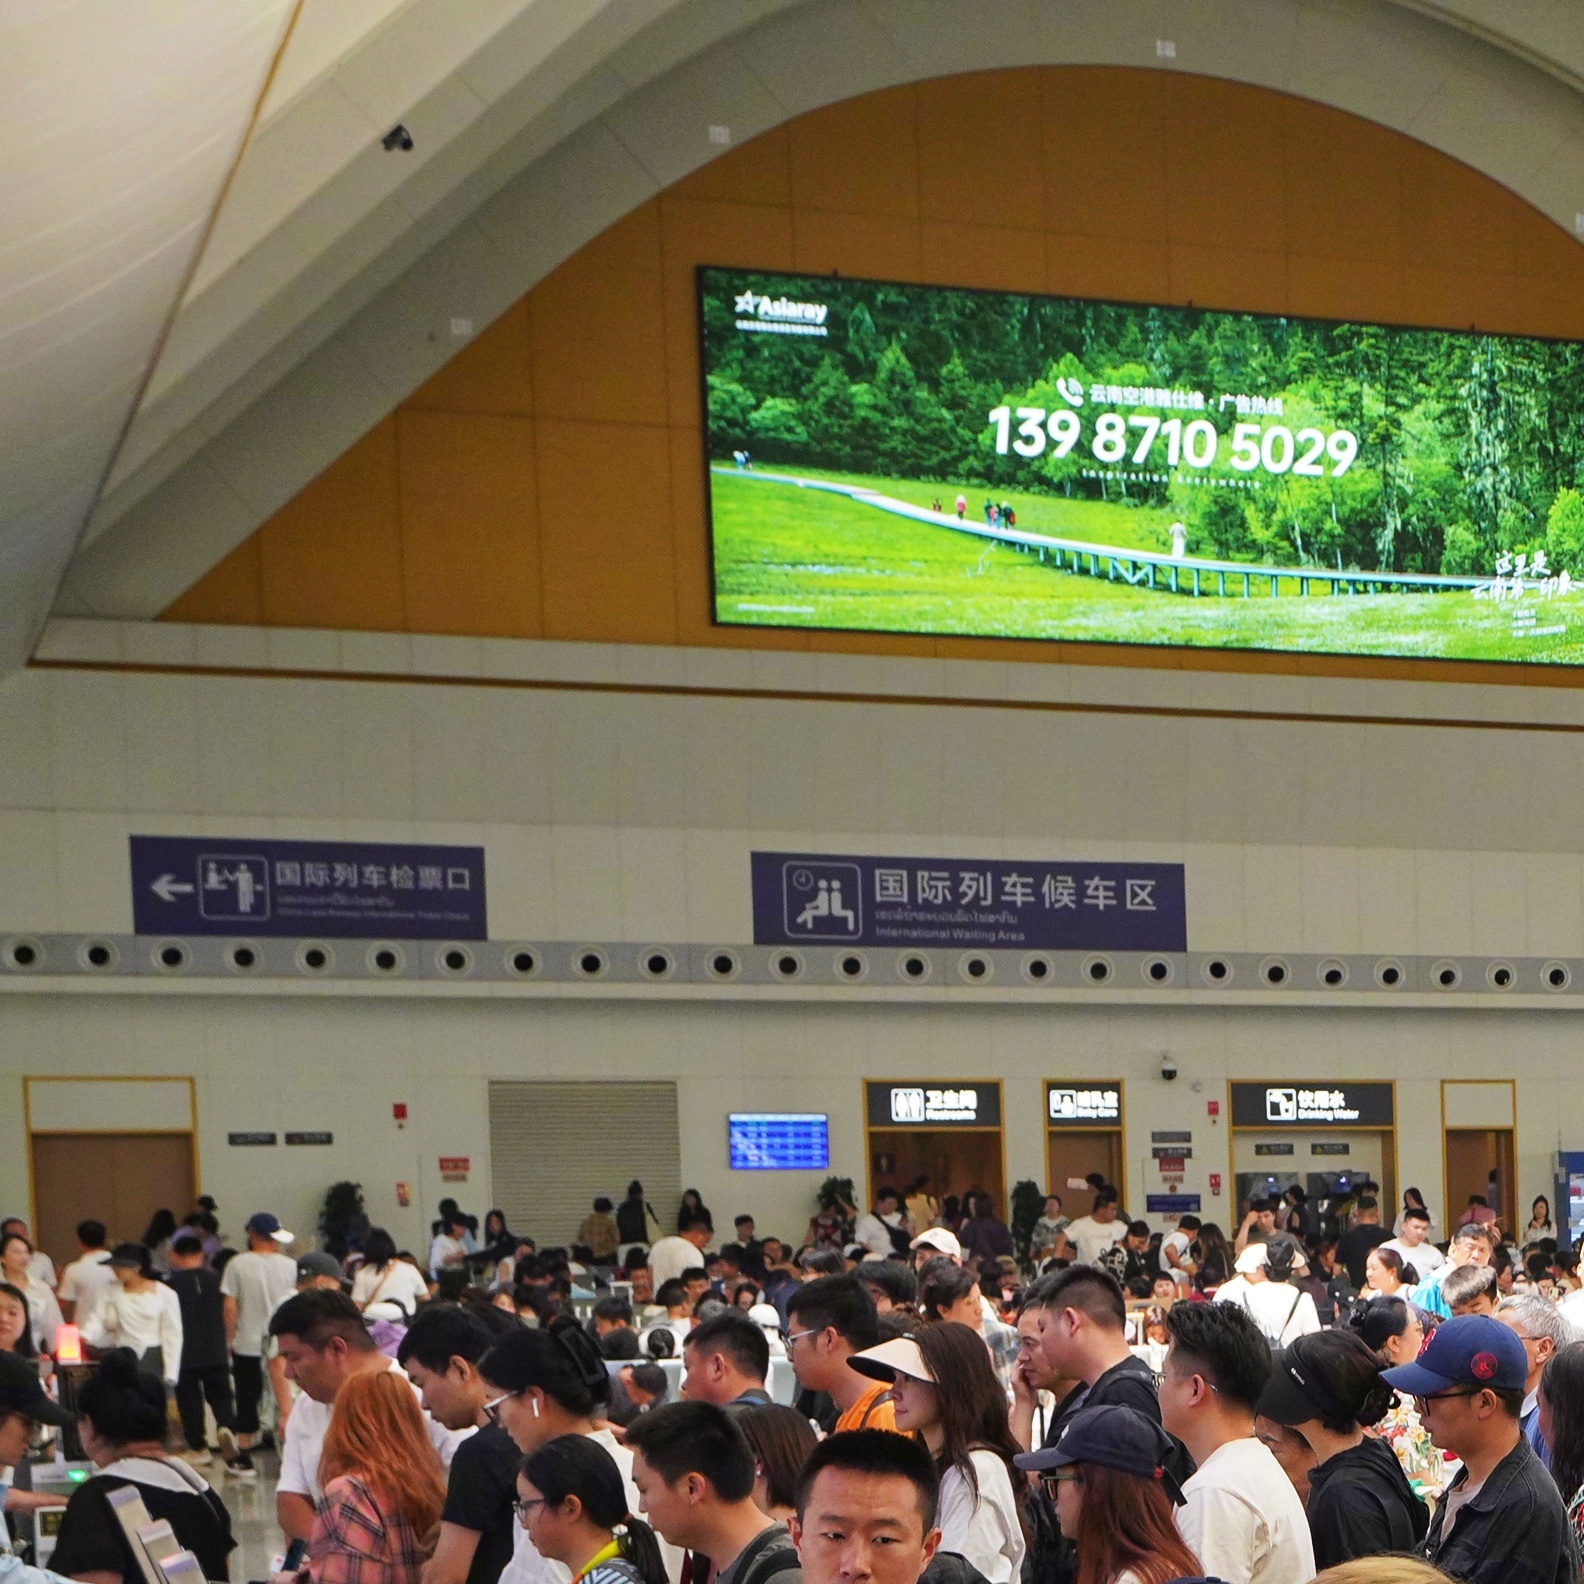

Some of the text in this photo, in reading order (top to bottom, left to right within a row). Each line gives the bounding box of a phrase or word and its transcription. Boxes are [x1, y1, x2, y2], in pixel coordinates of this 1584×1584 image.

[988, 405, 1359, 478] 139 8710 5029
[275, 860, 470, 891] 国际列车检票口
[874, 868, 1157, 911] 国际列车候车区
[875, 926, 1025, 943] International Waiting Area
